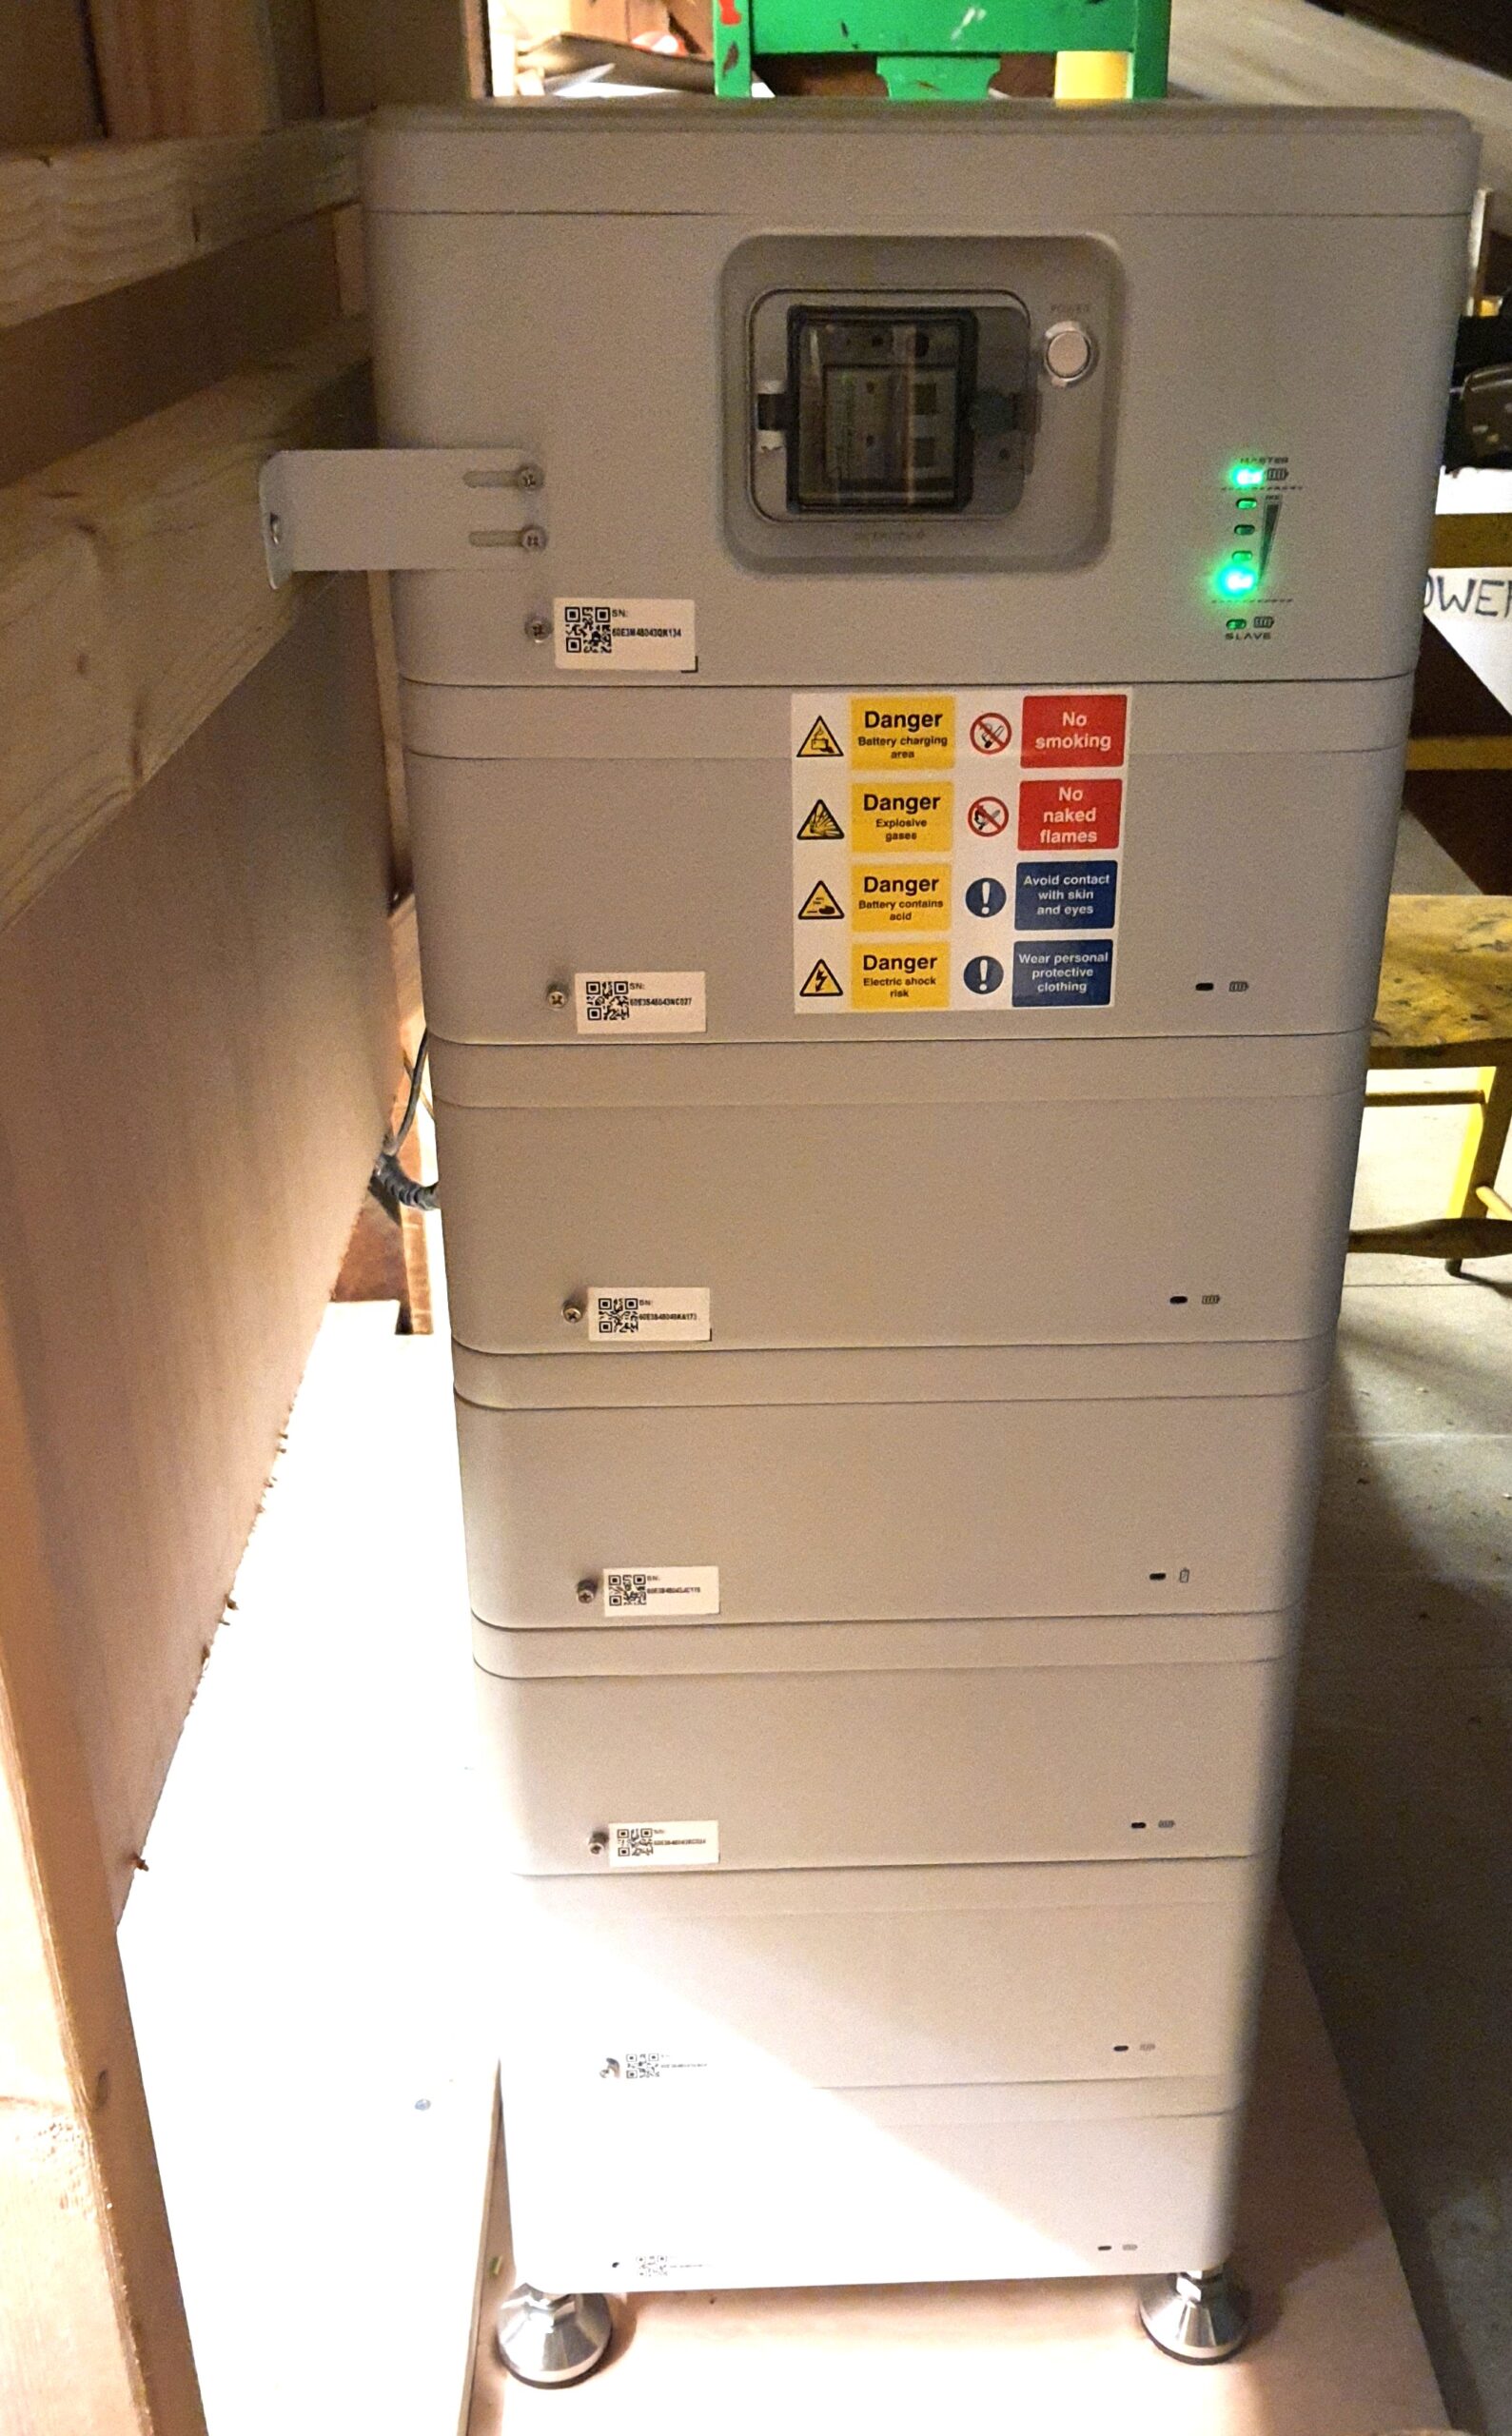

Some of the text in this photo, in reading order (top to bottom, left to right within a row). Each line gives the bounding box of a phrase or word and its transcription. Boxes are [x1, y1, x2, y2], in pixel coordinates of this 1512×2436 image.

[1225, 632, 1272, 640] SLAVE
[864, 710, 943, 733] Danger
[1062, 711, 1088, 727] No
[857, 736, 949, 748] Battery charging
[1034, 733, 1111, 752] smoking
[890, 751, 915, 759] area
[1058, 786, 1084, 801] No
[863, 794, 941, 815] Danger
[1043, 807, 1097, 823] naked
[875, 817, 928, 830] Explosive
[885, 832, 917, 843] gases
[1039, 829, 1097, 844] flames
[863, 875, 940, 897] Danger
[1023, 874, 1110, 886] Avoid contact
[1037, 889, 1094, 900] with skin
[858, 899, 944, 911] Battery contains
[1036, 905, 1094, 917] and eyes
[889, 912, 913, 921] acid
[863, 954, 938, 974] Danger
[1018, 952, 1109, 966] Wear personal
[1031, 967, 1093, 980] protective
[863, 975, 936, 987] Electric shock
[1036, 981, 1088, 994] clothing
[890, 989, 910, 998] risk
